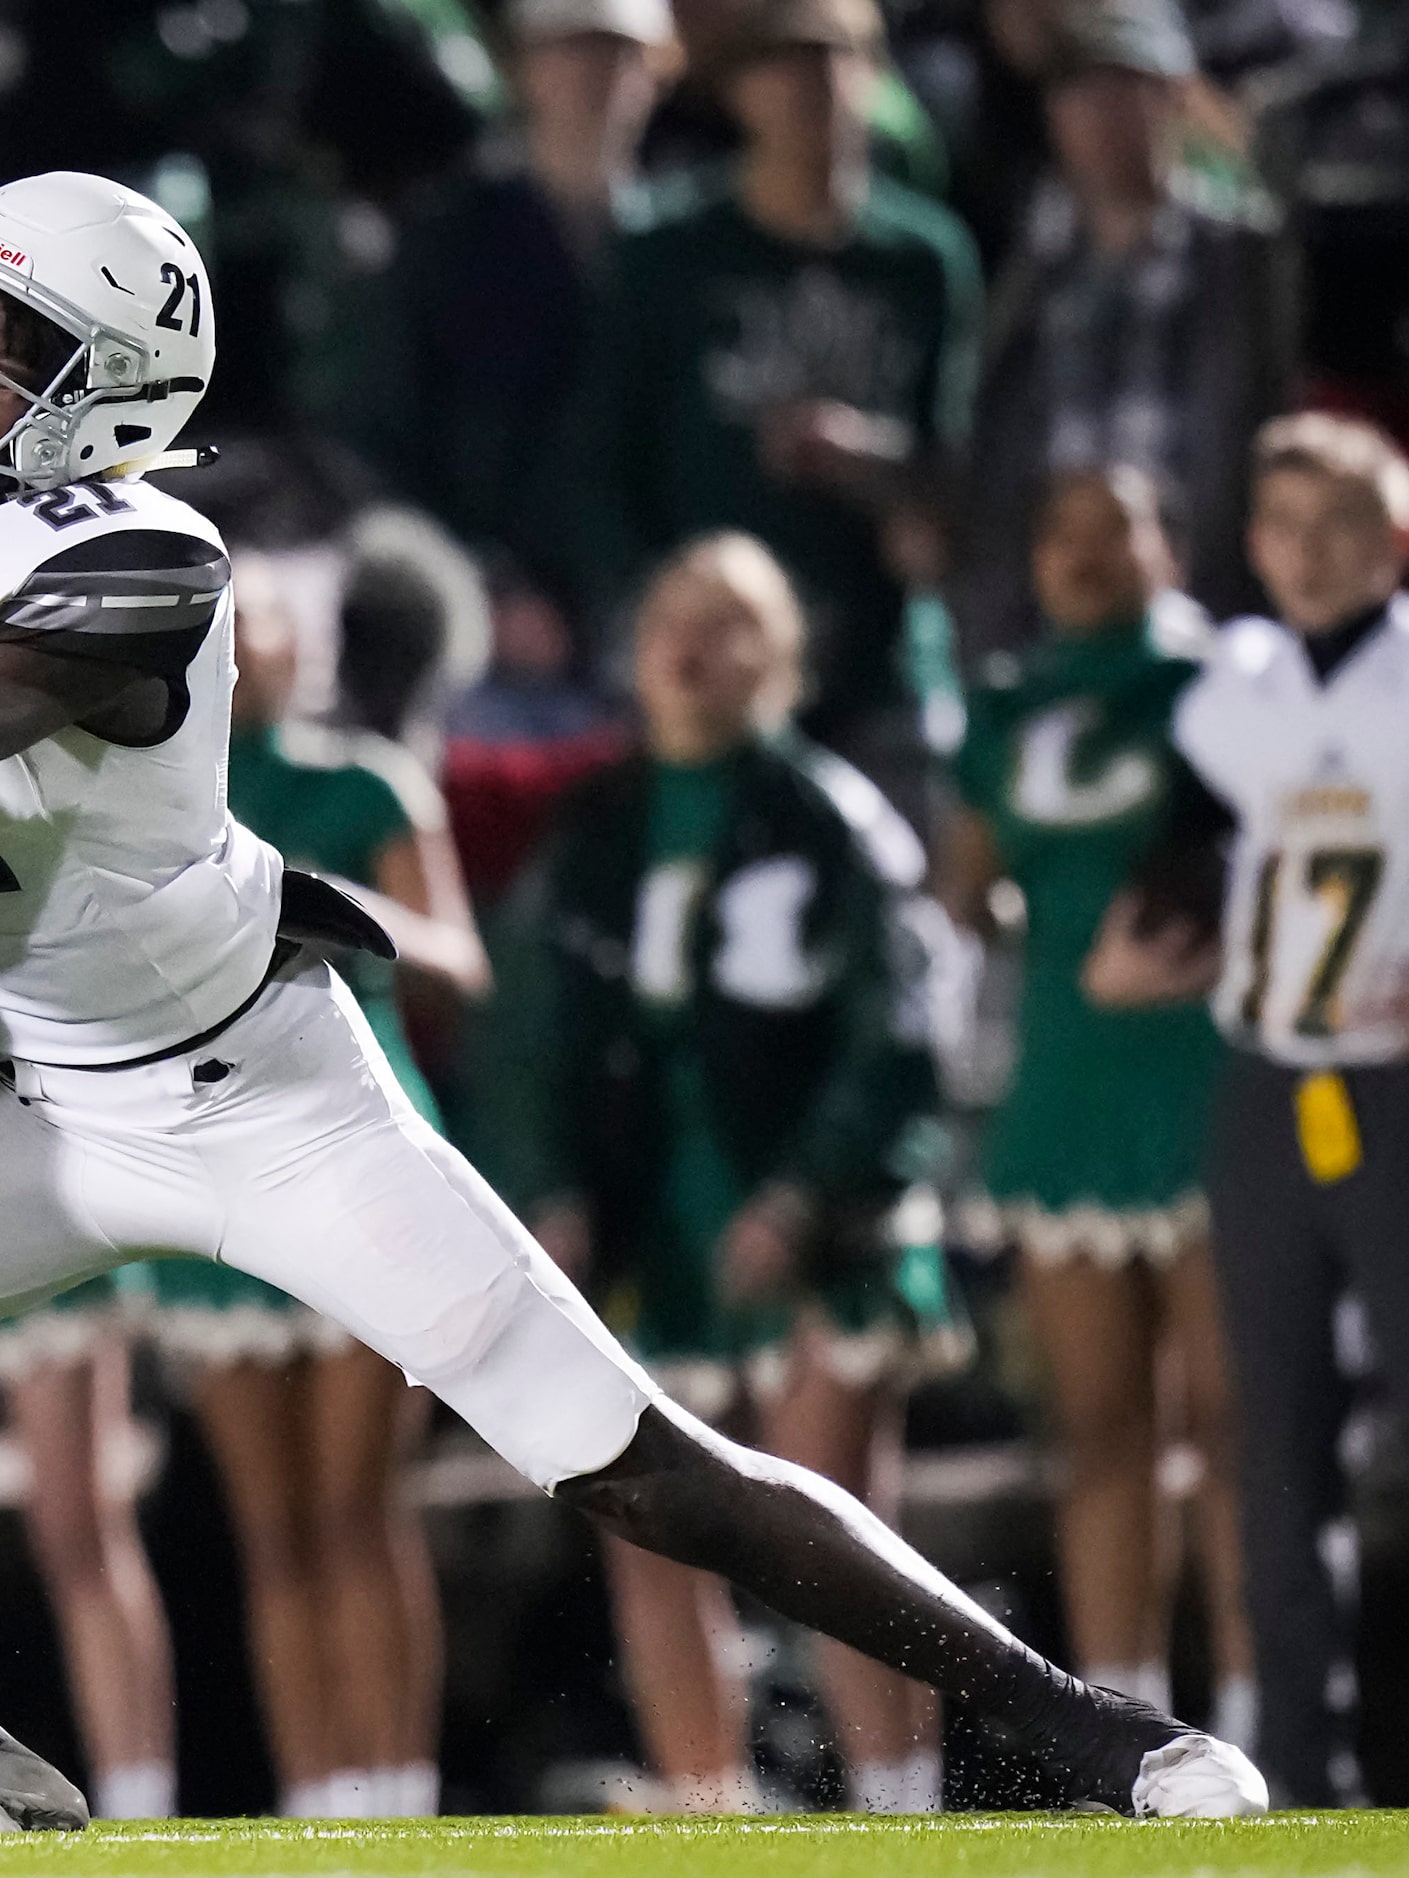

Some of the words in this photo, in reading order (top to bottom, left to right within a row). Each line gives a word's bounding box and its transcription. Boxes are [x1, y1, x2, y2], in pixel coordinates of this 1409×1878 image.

[155, 262, 201, 338] 21
[15, 481, 138, 532] 21
[1240, 845, 1389, 1038] 17
